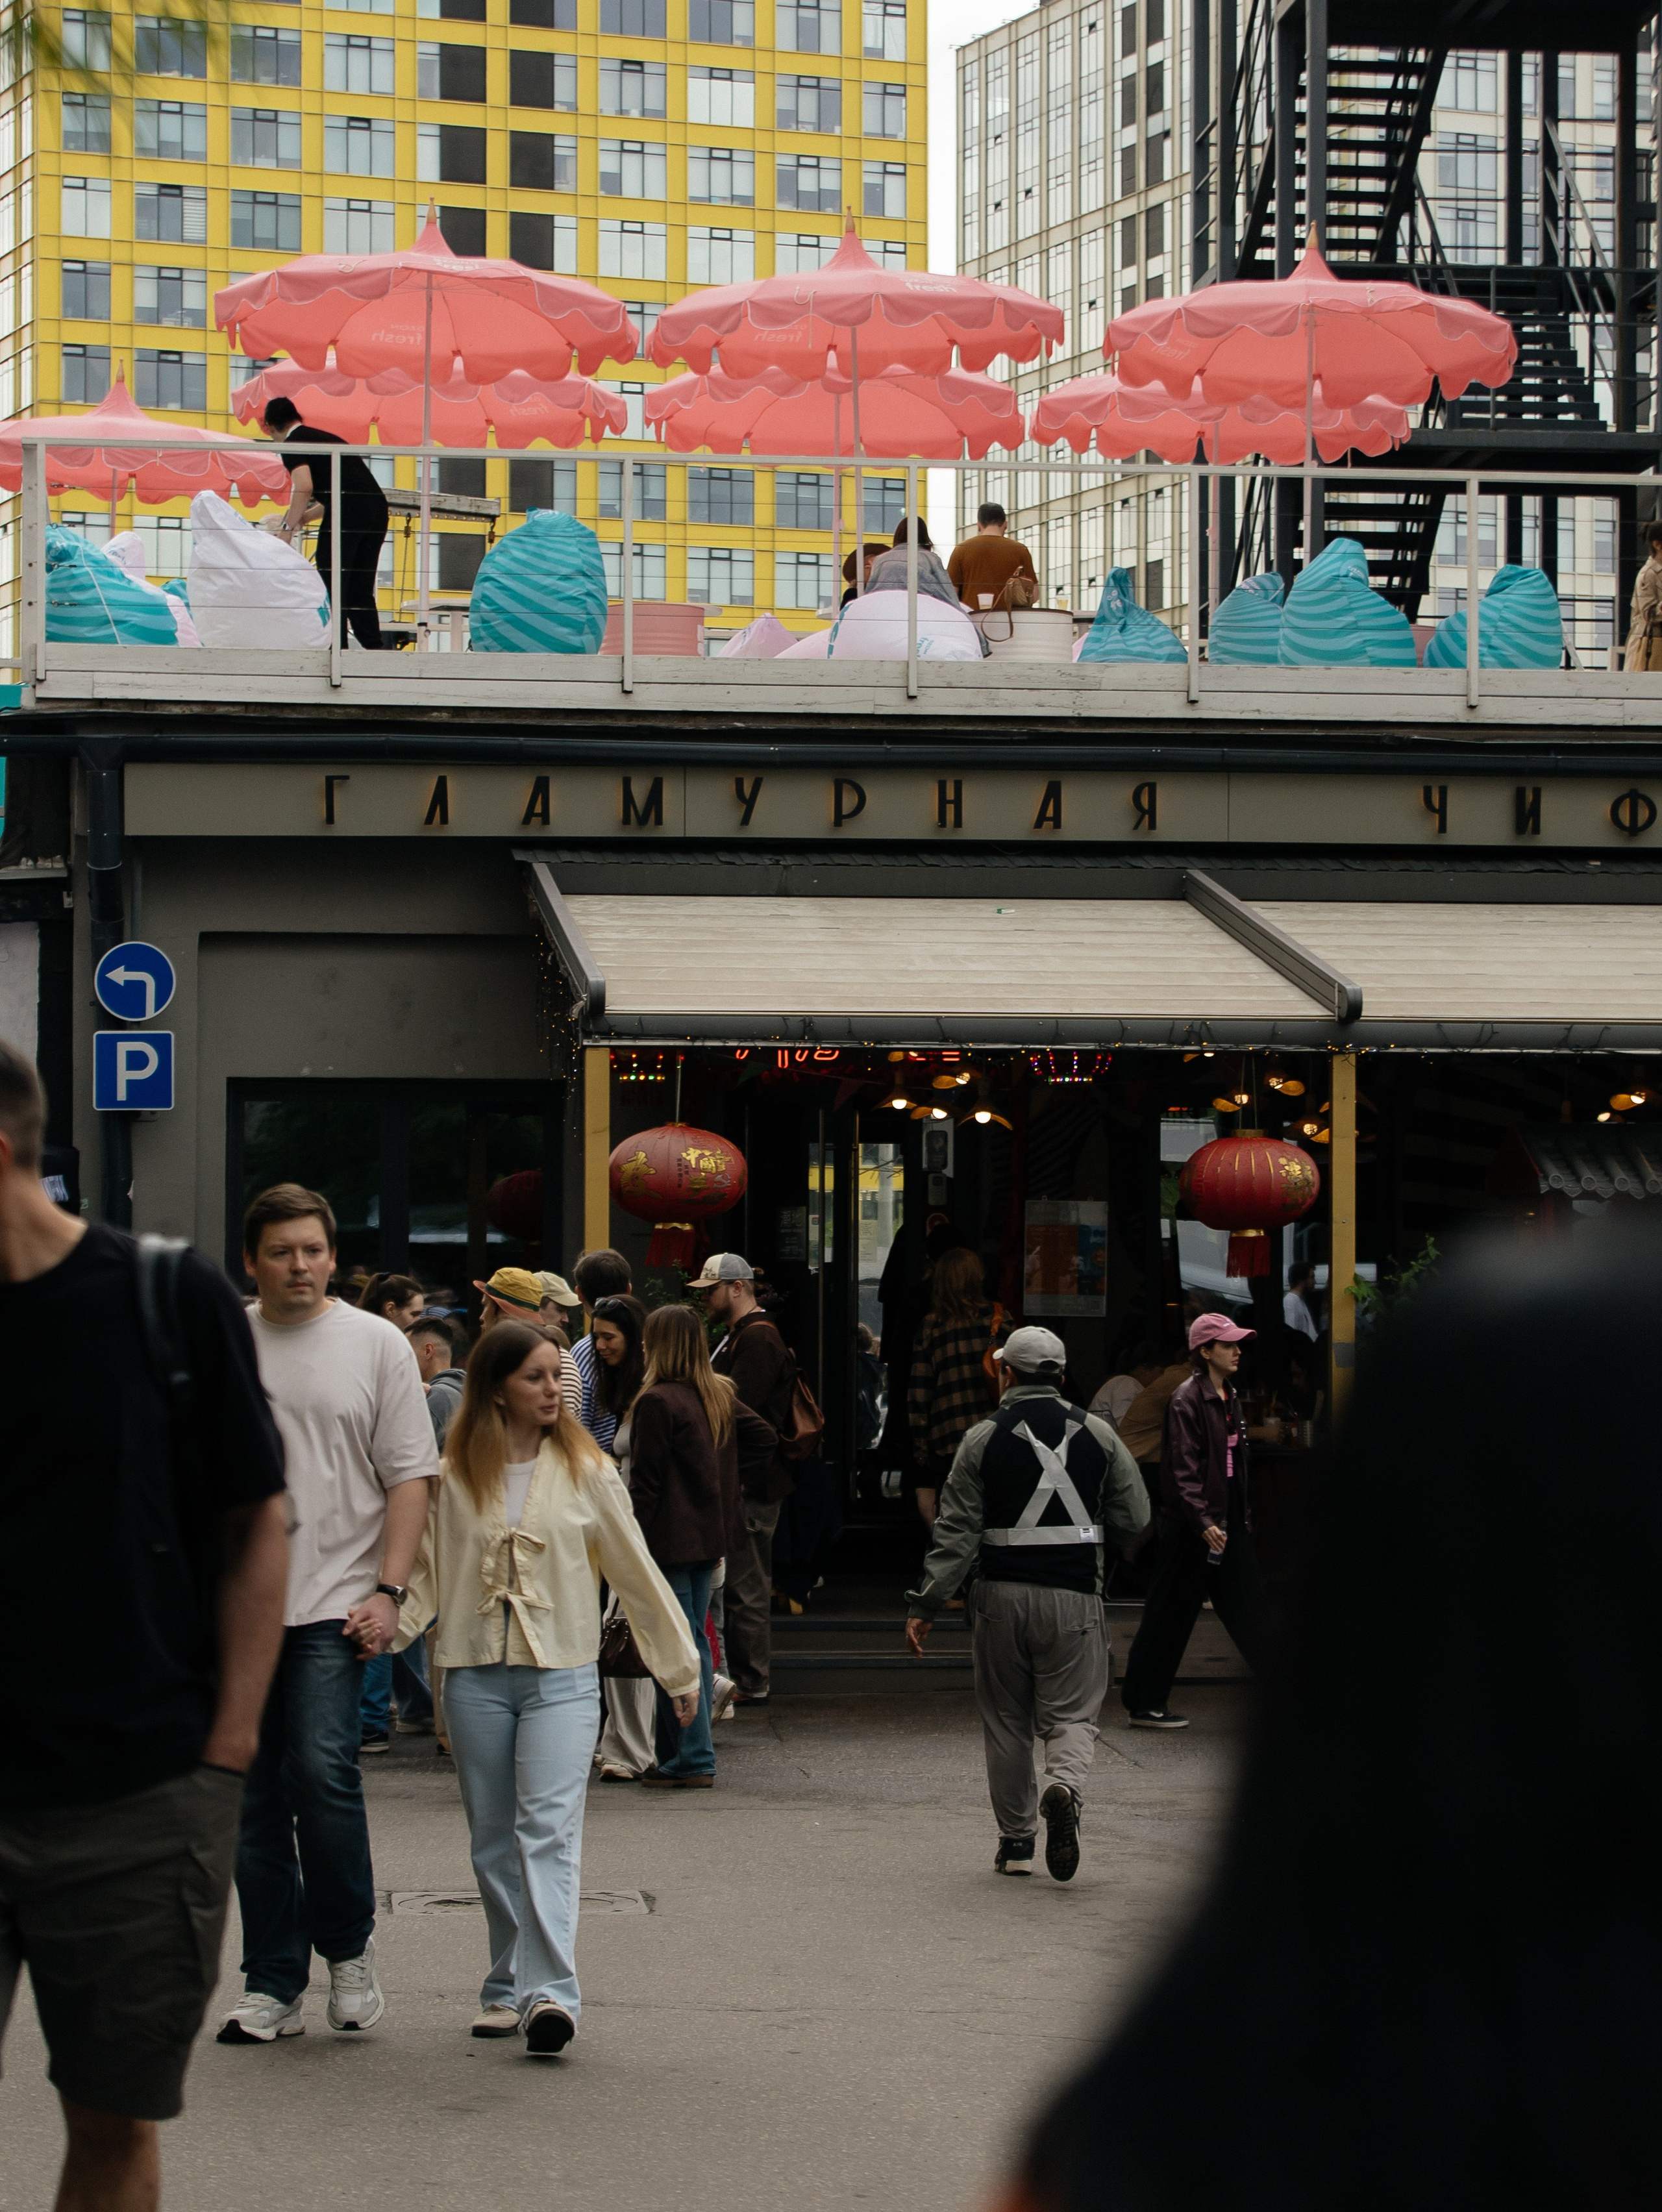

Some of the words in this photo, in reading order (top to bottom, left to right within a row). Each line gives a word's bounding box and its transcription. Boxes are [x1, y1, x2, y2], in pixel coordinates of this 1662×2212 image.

[325, 775, 1157, 831] ГЛАМУРНАЯ
[1422, 785, 1657, 837] ЧИФ
[116, 1041, 159, 1101] P
